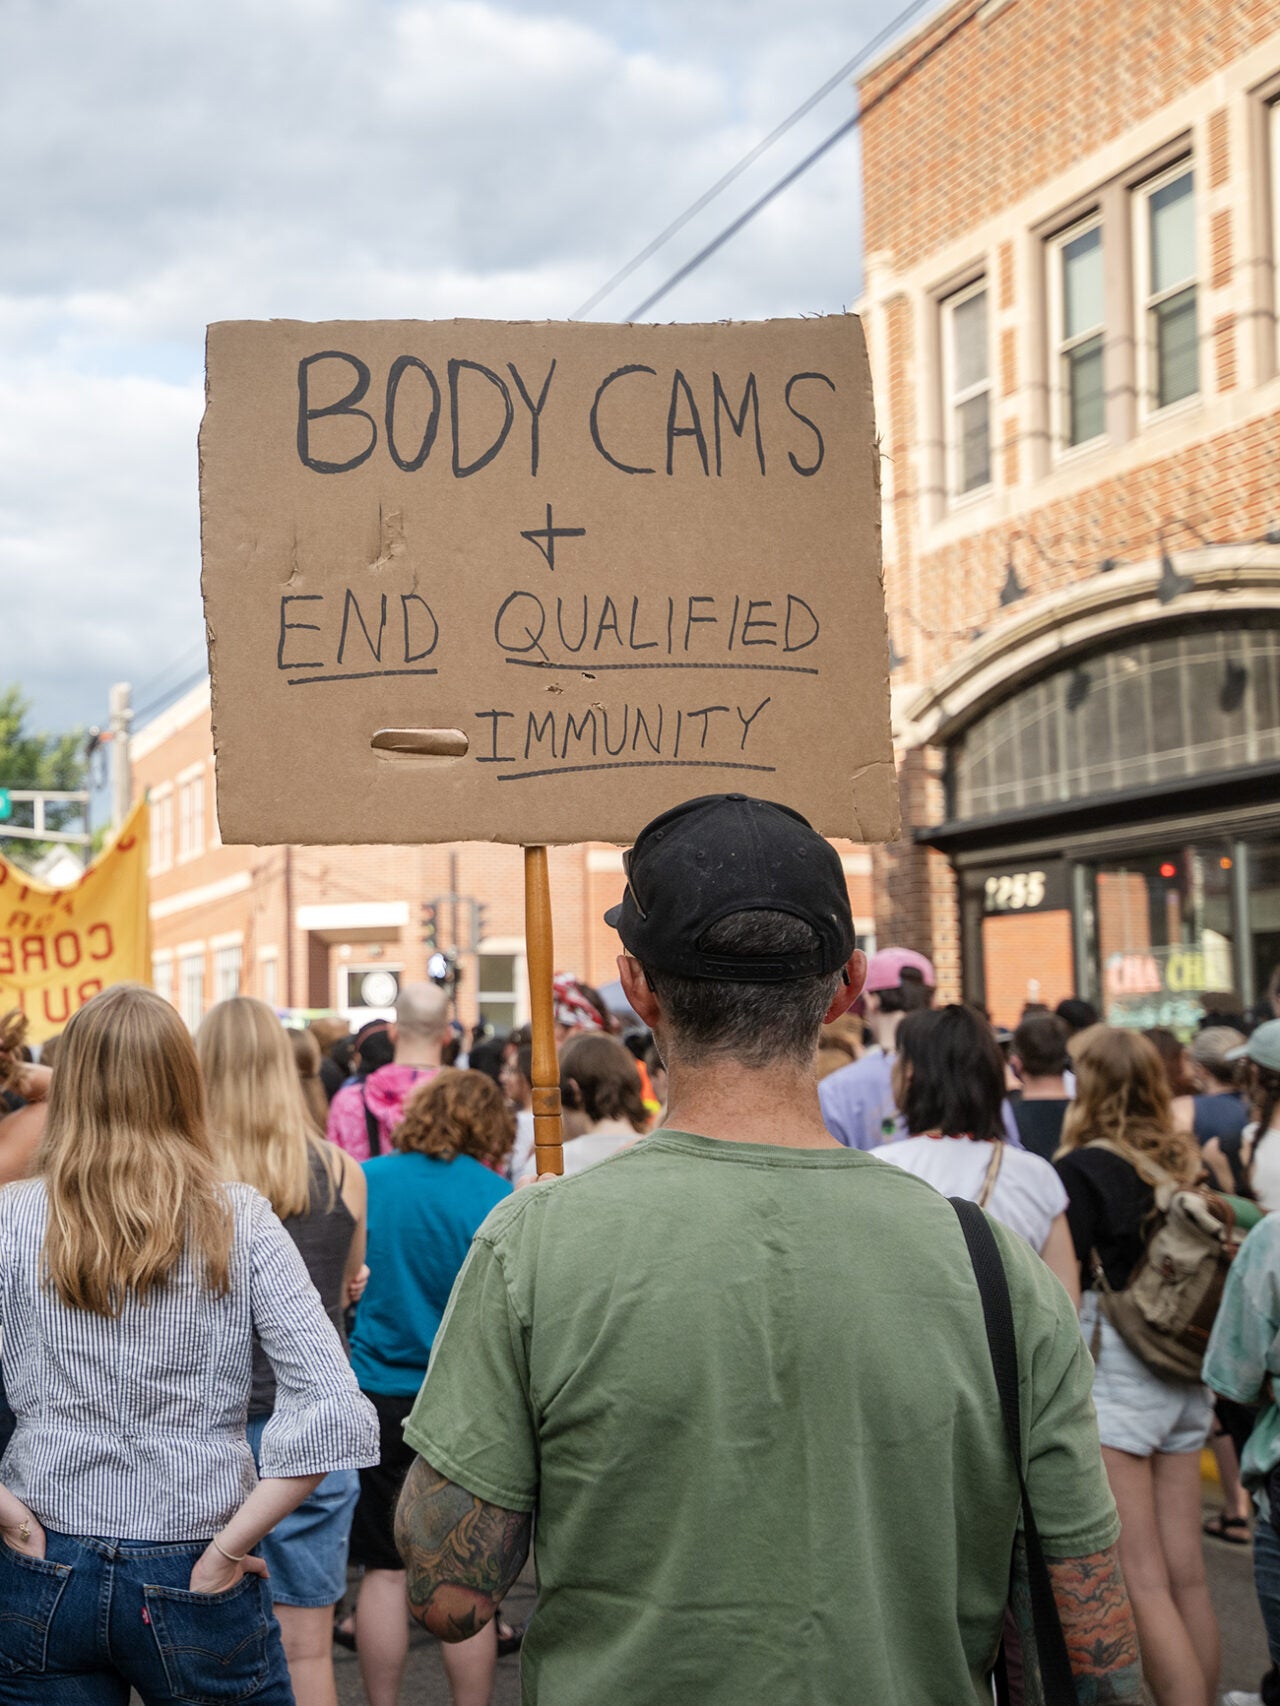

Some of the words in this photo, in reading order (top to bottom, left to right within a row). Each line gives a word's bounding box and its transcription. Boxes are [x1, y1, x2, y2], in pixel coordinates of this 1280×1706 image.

[297, 351, 556, 478] BODY
[590, 364, 836, 477] CAMS
[278, 588, 439, 669] END
[494, 591, 819, 661] QUALIFIED
[475, 697, 771, 762] IMMUNITY
